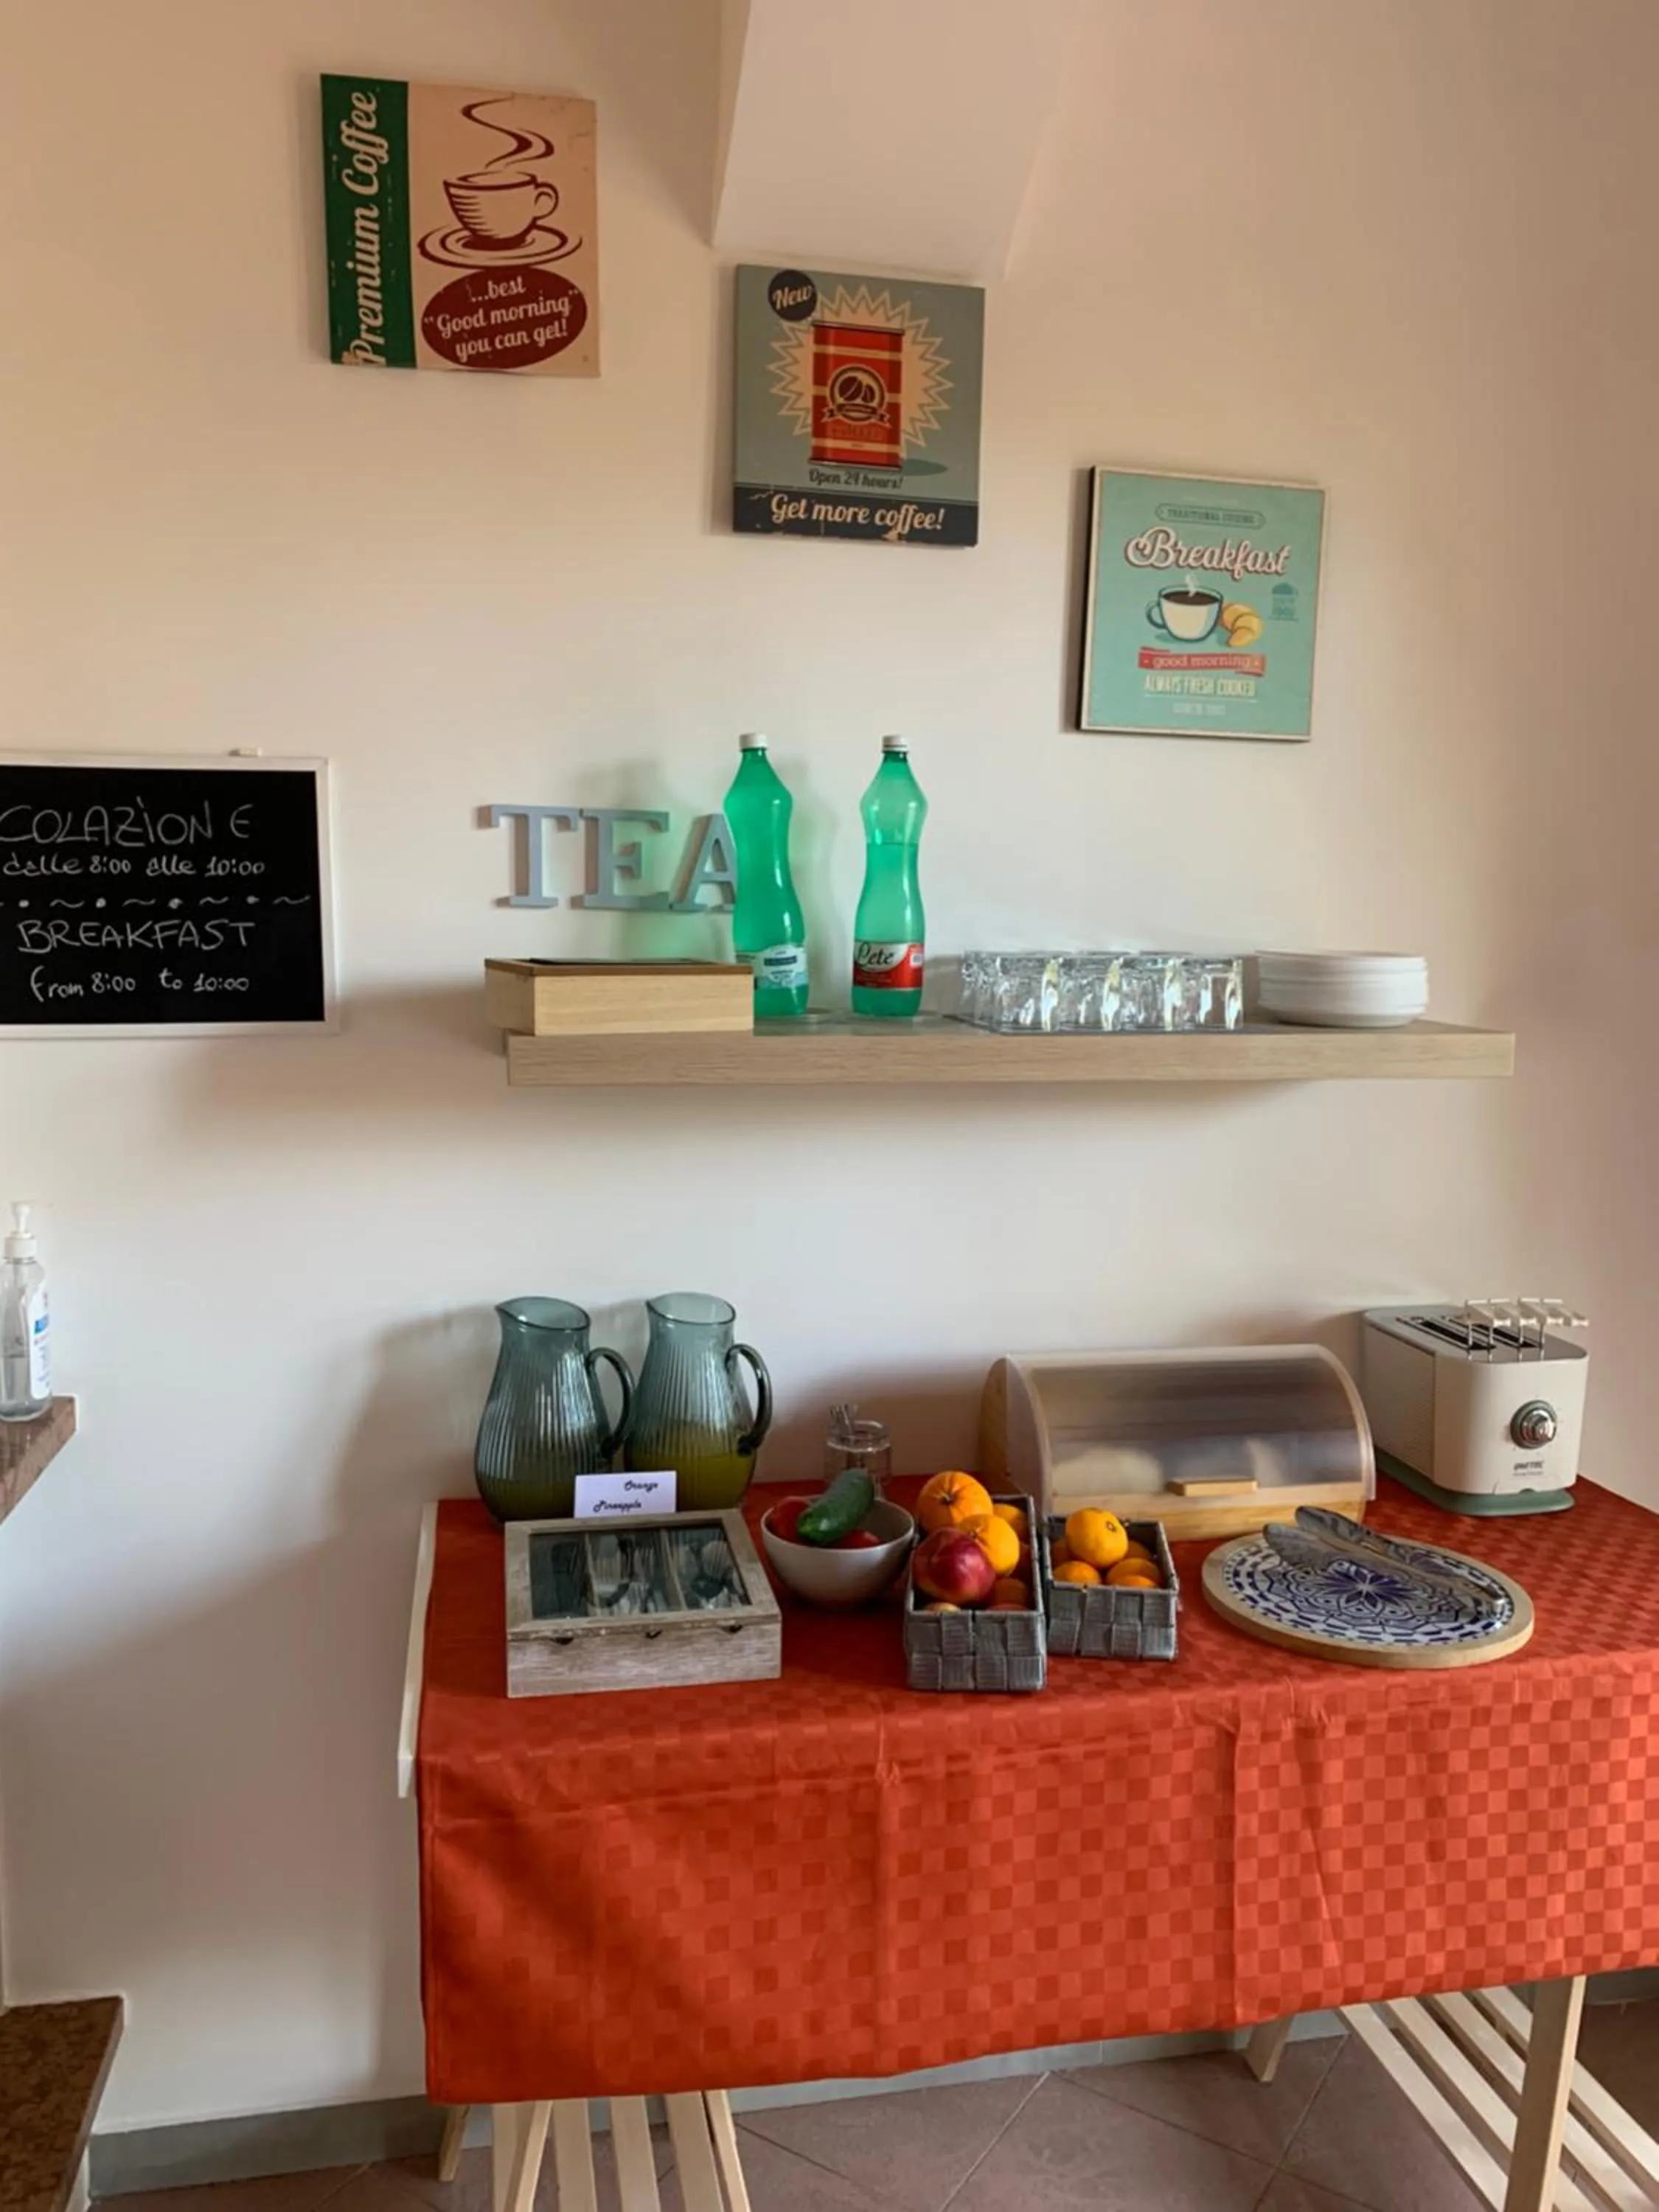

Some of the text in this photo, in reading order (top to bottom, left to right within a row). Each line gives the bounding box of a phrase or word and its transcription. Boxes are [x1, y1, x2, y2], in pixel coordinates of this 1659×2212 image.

[340, 91, 389, 366] Premium Coffee
[773, 285, 815, 310] New
[455, 319, 568, 364] you can get!
[810, 468, 841, 486] Open
[844, 472, 860, 485] 24
[771, 493, 945, 534] Get more coffee!
[1124, 526, 1291, 582] Breakfast
[88, 855, 132, 874] 8:00
[204, 857, 266, 877] 10:00
[478, 804, 736, 913] TEA
[16, 918, 255, 953] BREAKFAST
[29, 964, 250, 1003] from 8:00 to 10:00
[624, 1480, 659, 1493] Orange
[593, 1499, 642, 1513] Pineapple
